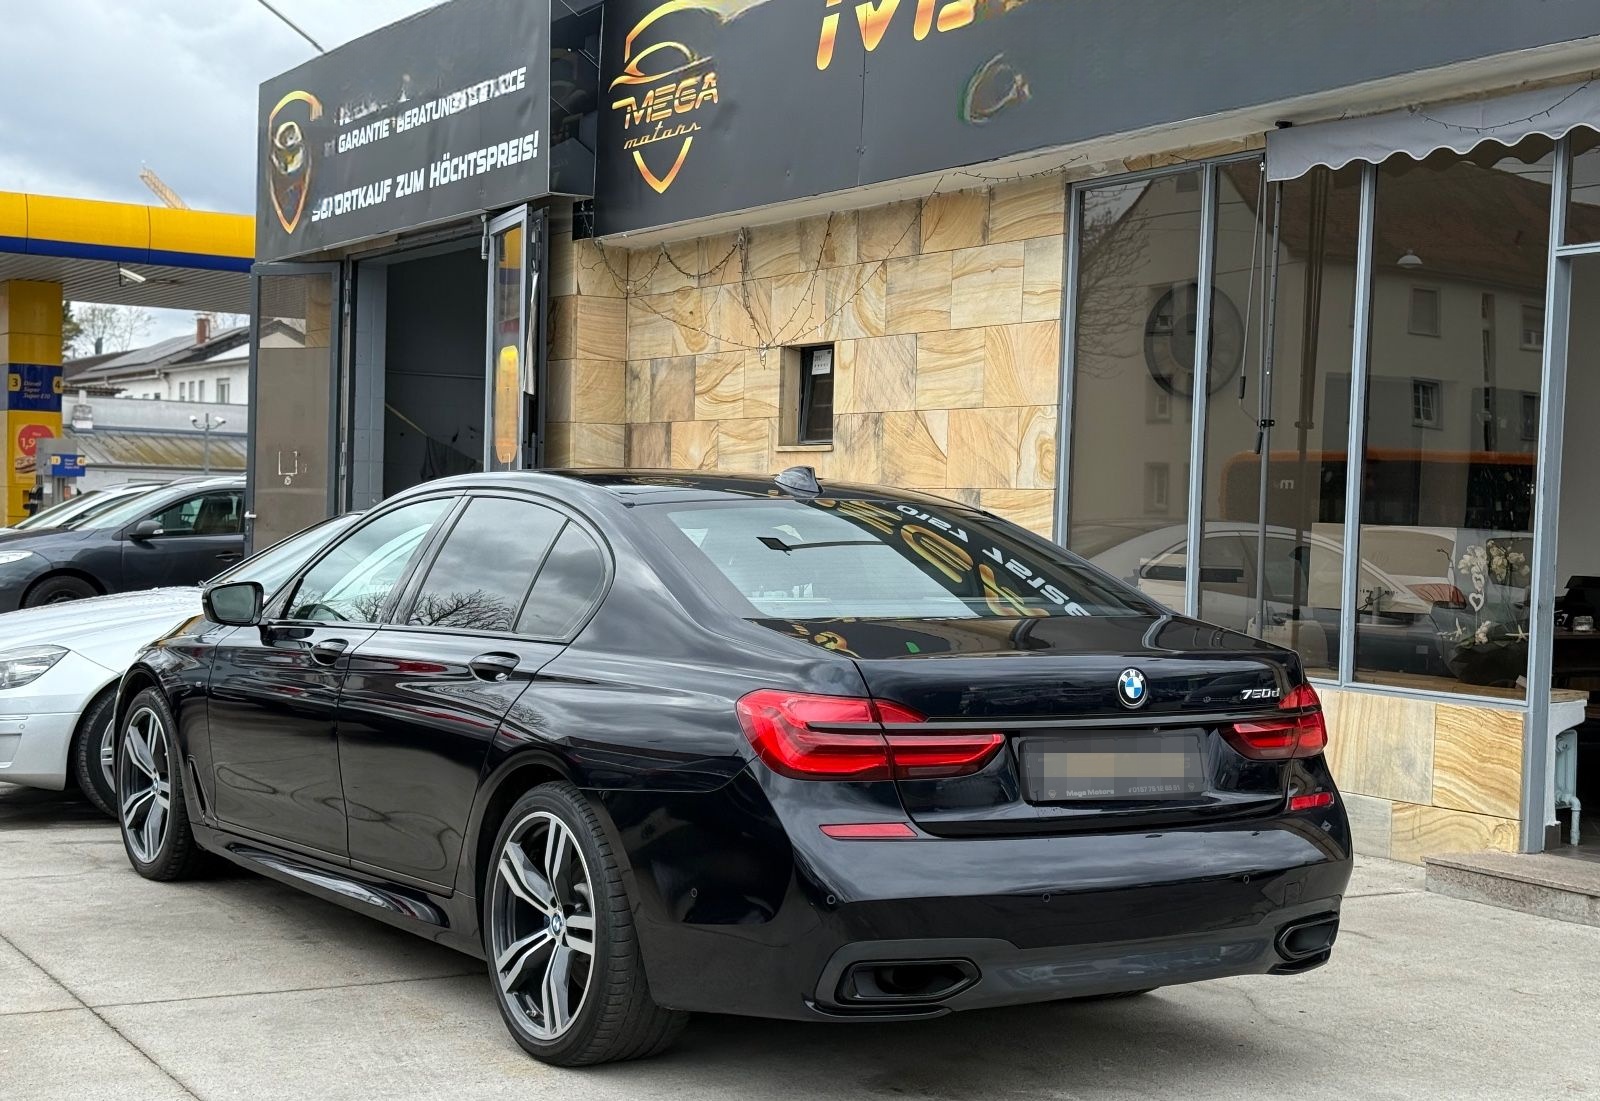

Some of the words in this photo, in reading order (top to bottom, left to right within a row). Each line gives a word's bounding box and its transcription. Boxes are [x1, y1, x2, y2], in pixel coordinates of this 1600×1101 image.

[611, 72, 719, 130] MEGA
[338, 119, 390, 154] GARANTIE
[623, 120, 702, 150] motors
[395, 168, 424, 198] ZUM
[429, 130, 539, 189] HÖCHTSPREIS!
[12, 378, 18, 387] 3
[55, 380, 61, 389] 4
[1241, 687, 1281, 701] 750d
